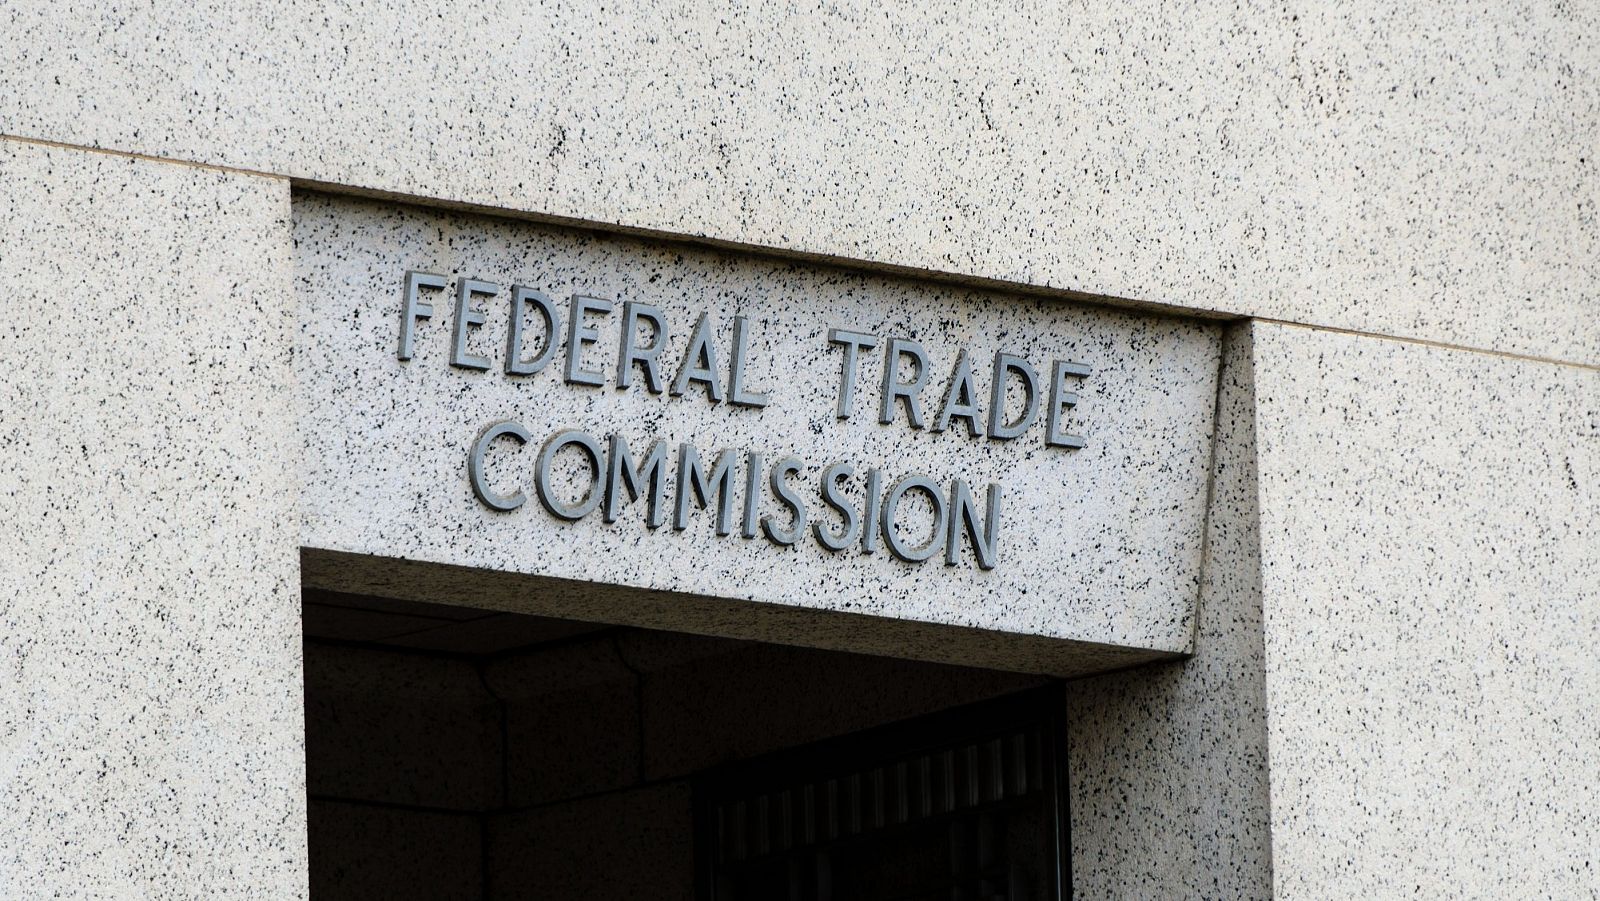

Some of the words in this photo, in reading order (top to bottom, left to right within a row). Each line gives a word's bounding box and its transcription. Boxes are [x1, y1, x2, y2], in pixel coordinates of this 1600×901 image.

[397, 270, 768, 408] FEDERAL
[828, 328, 1091, 449] TRADE
[468, 420, 1000, 570] COMMISSION
